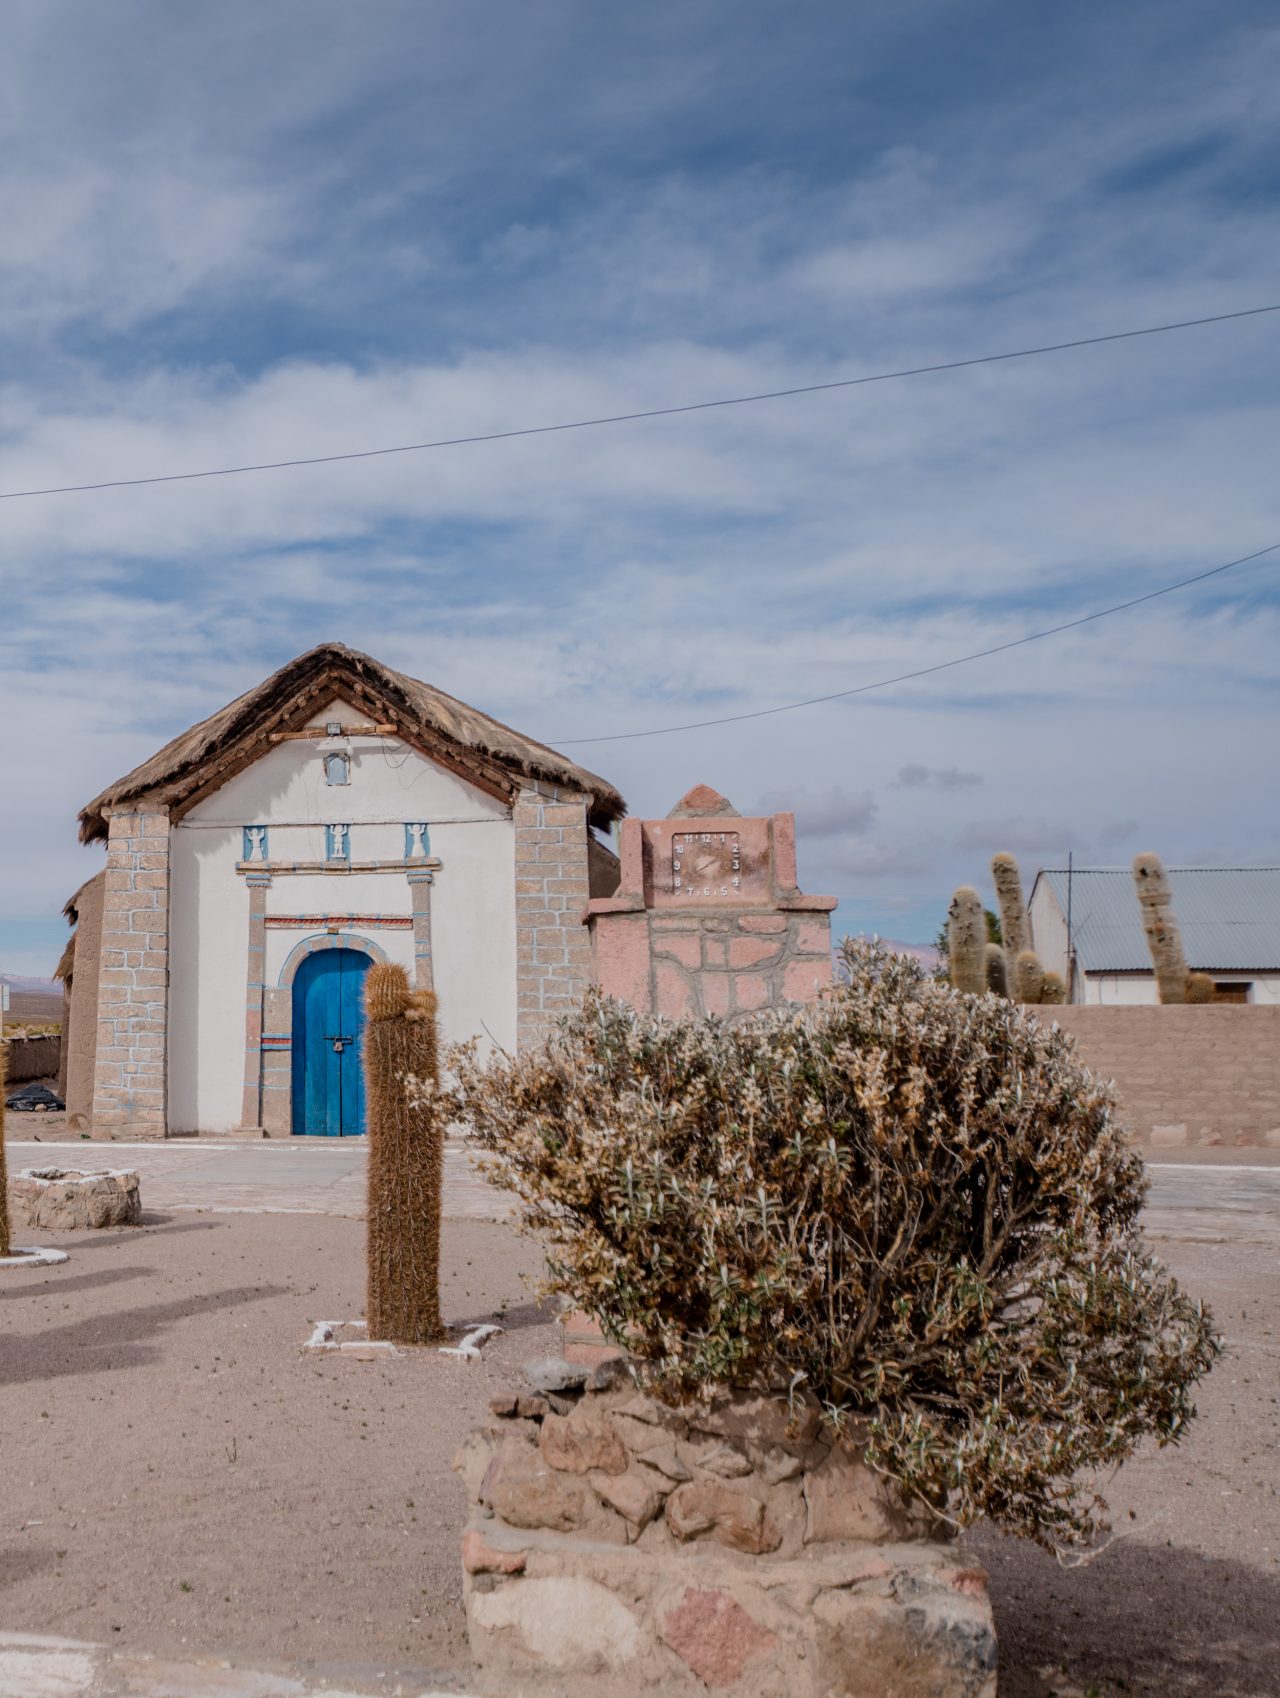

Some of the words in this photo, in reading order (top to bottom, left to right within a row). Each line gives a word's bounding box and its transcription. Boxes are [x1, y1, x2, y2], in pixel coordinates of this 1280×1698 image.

[684, 835, 693, 843] 11
[701, 834, 711, 843] 12
[720, 834, 725, 843] 1
[732, 844, 739, 852] 2
[674, 861, 680, 870] 9
[733, 860, 739, 869] 3
[674, 877, 681, 887] 8
[732, 877, 739, 886] 4
[687, 887, 694, 895] 7
[704, 887, 711, 896] 6
[721, 887, 728, 896] 5
